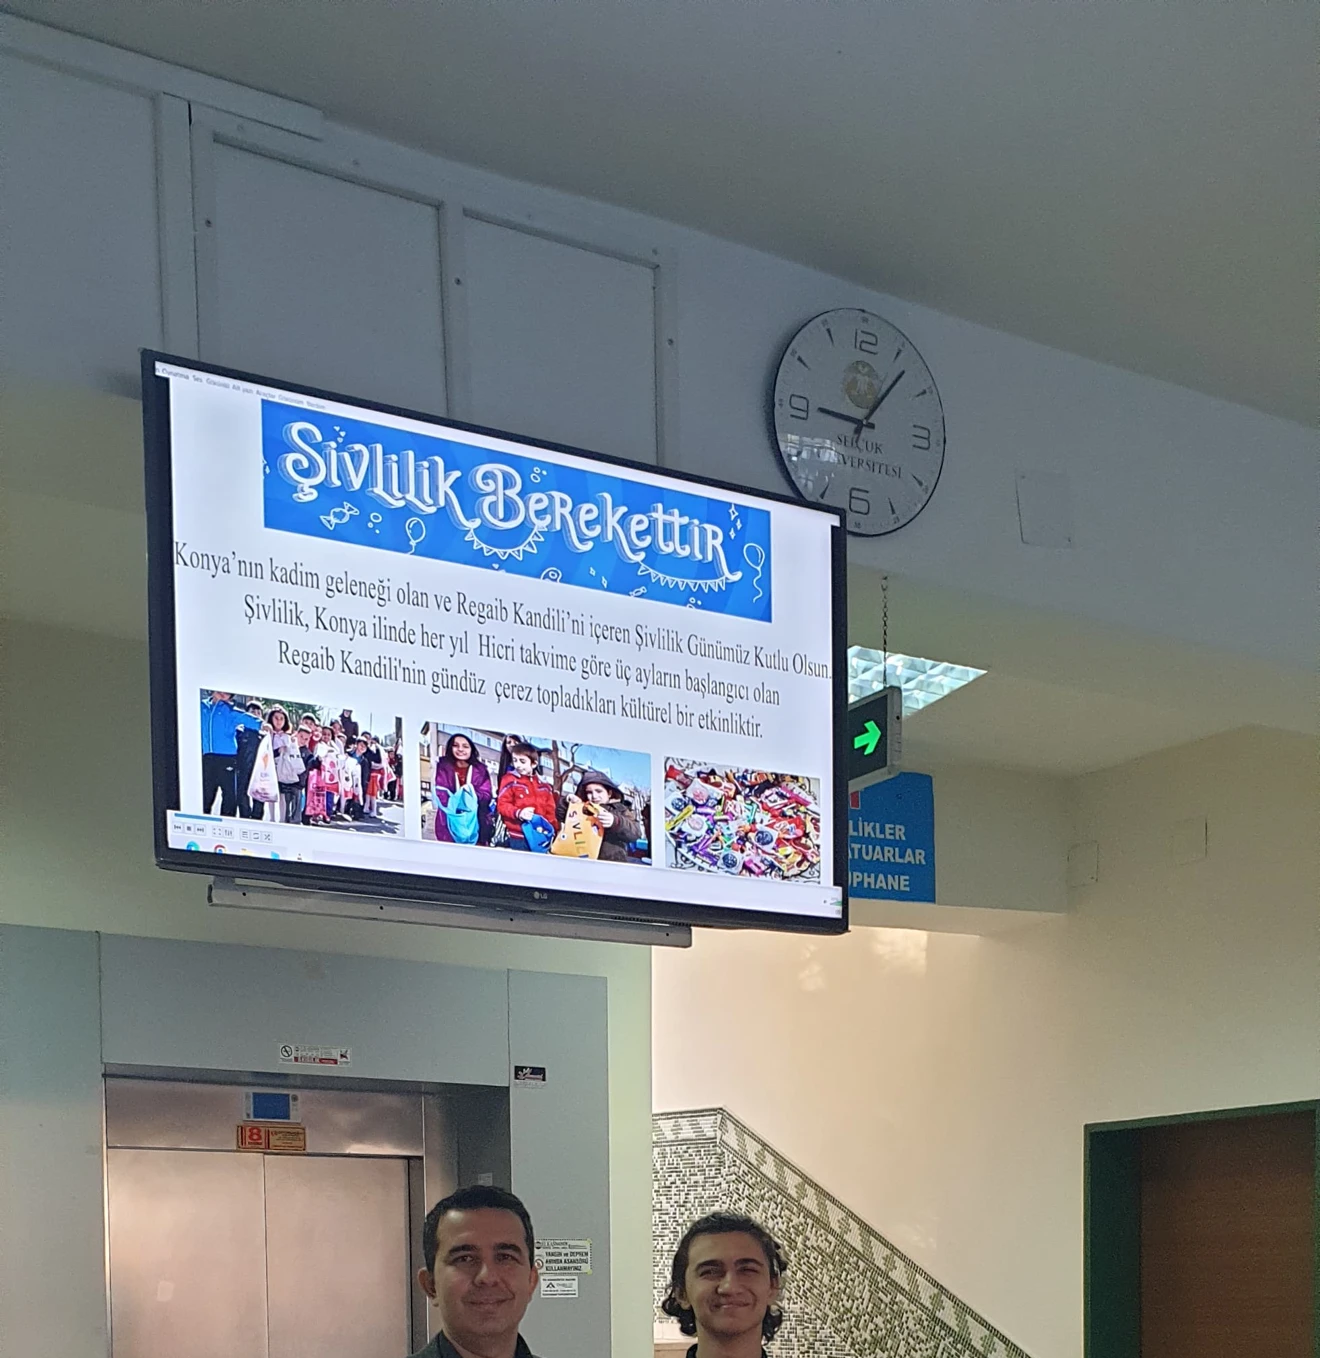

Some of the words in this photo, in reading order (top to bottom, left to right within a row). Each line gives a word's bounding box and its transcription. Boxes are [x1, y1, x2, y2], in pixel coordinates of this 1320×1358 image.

[854, 328, 879, 355] 12
[789, 393, 810, 420] 9
[912, 424, 931, 450] 3
[849, 487, 870, 516] 6
[269, 558, 320, 590] kadim
[325, 571, 392, 607] geleneği
[396, 582, 429, 608] olan
[434, 594, 452, 612] ve
[456, 591, 508, 625] Regaib
[589, 615, 631, 644] içeren
[635, 624, 684, 653] Şivlilik
[687, 634, 751, 665] Günümüz
[754, 646, 789, 672] Kutlu
[792, 652, 832, 680] Olsun.
[243, 594, 310, 632] Şivlilik,
[314, 605, 368, 641] Konya
[372, 615, 416, 645] ilinde
[421, 623, 445, 650] her
[449, 631, 469, 658] yıl
[478, 633, 515, 661] Hicri
[520, 642, 577, 672] takvime
[581, 655, 612, 680] göre
[615, 659, 632, 687] üç
[635, 663, 681, 690] ayların
[685, 669, 749, 704] başlangıcı
[753, 682, 780, 706] olan
[278, 639, 335, 674] Regaib
[340, 649, 426, 686] Kandili'nin
[431, 667, 486, 695] gündüz
[494, 680, 533, 703] çerez
[537, 684, 616, 716] topladıkları
[620, 694, 672, 724] kültürel
[676, 704, 694, 728] bir
[698, 708, 763, 738] etkinliktir.
[848, 871, 910, 892] PHANE
